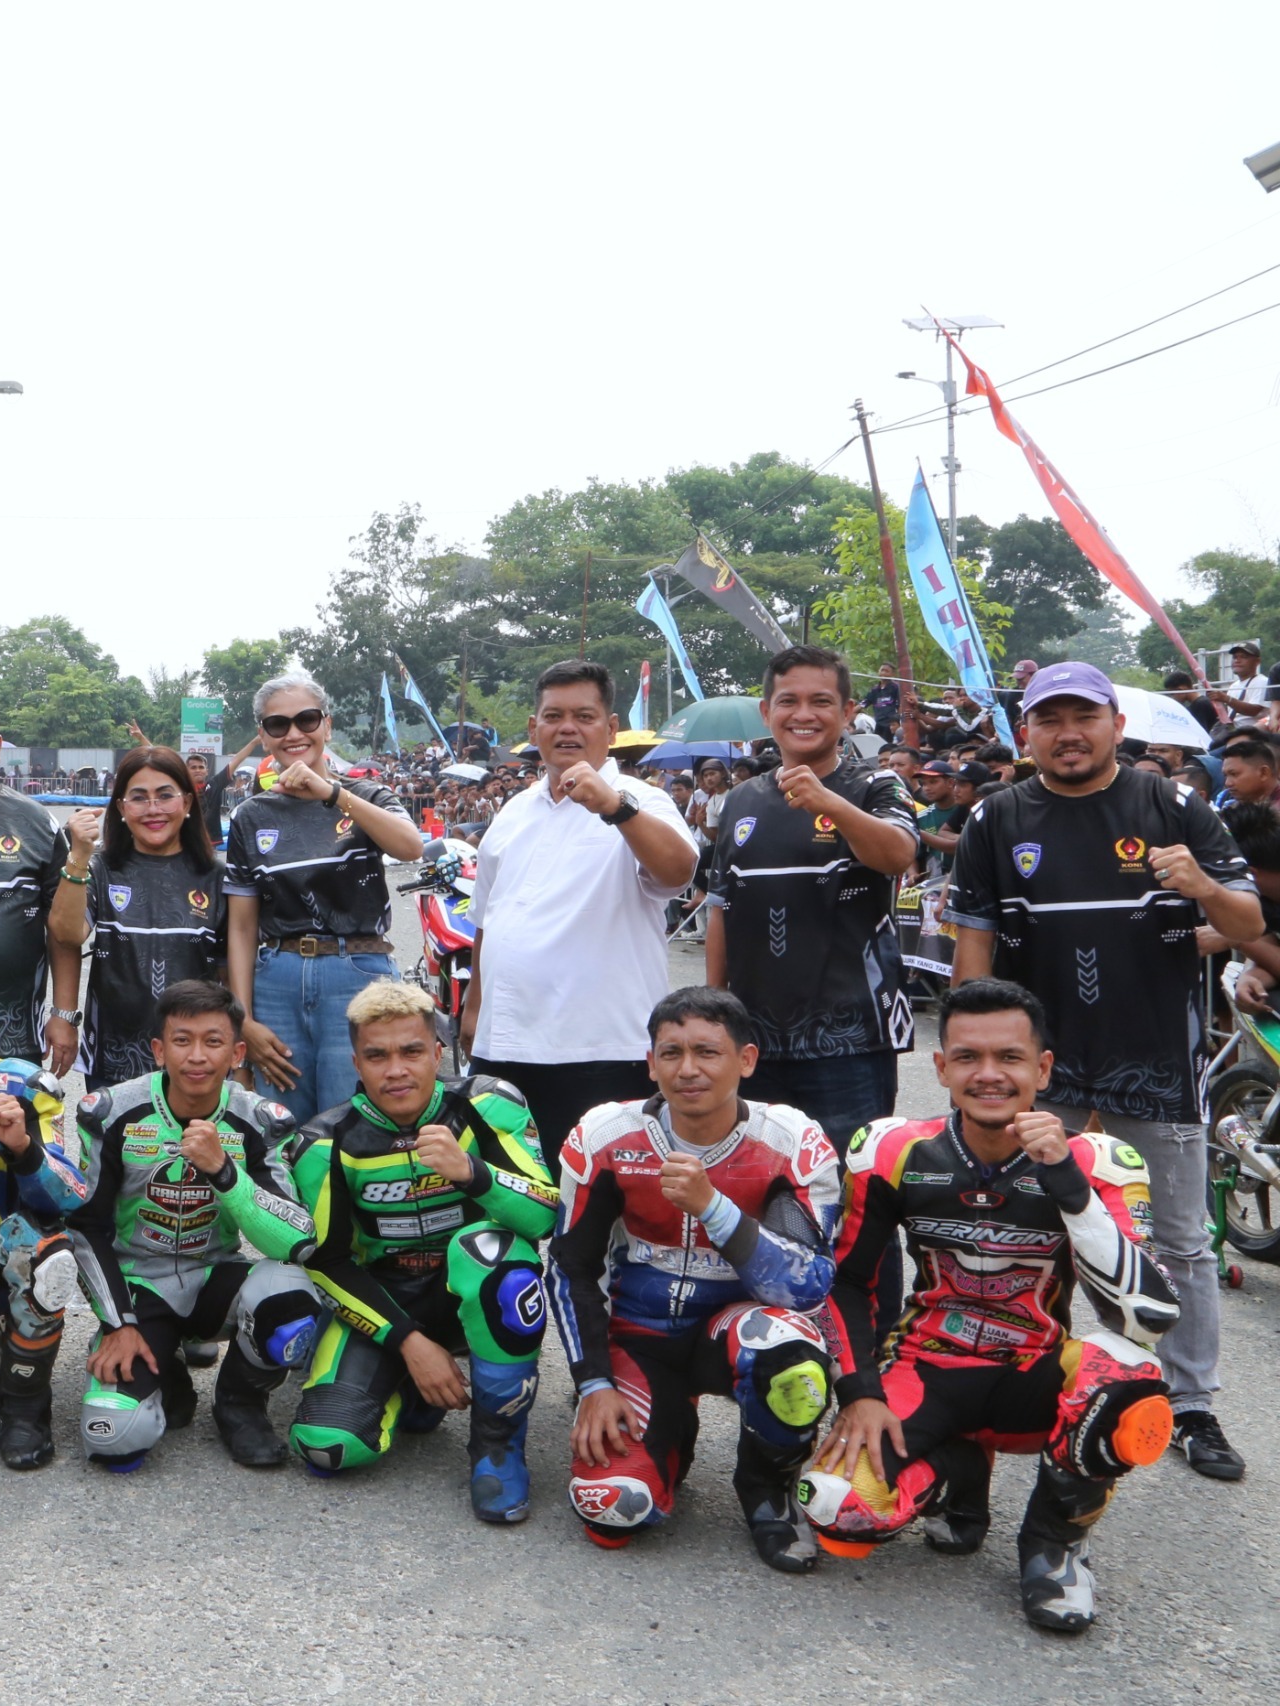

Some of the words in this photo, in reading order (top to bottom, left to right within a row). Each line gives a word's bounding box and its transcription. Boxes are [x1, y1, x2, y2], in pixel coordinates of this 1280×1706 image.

[362, 1181, 412, 1202] 88
[497, 1171, 528, 1195] 88
[914, 1219, 1062, 1246] BERINGIN
